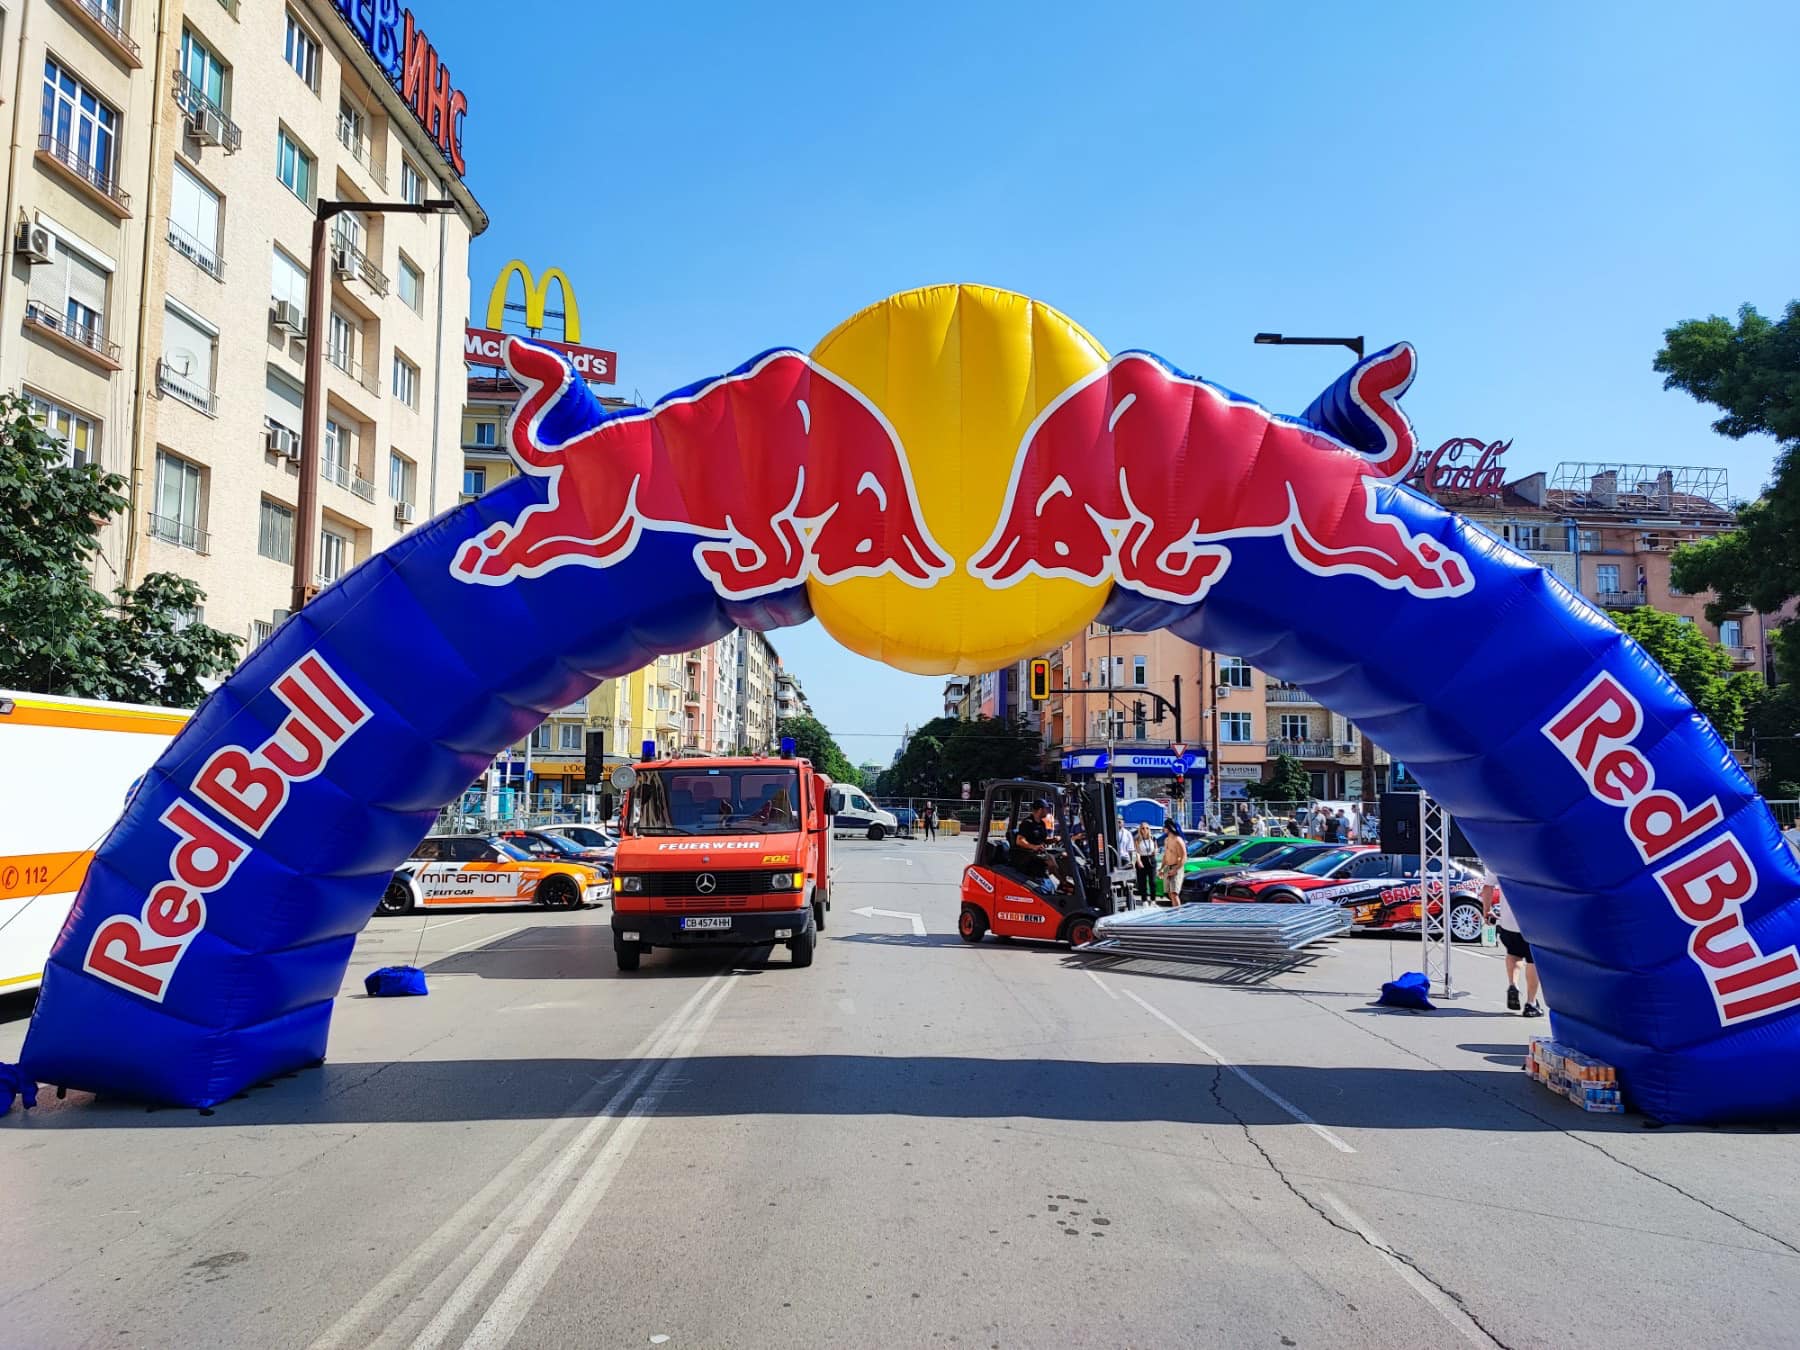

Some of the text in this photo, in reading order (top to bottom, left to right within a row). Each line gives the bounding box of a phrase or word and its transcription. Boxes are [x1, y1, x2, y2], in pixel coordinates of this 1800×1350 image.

[1132, 756, 1172, 765] ОПТИКА
[83, 649, 374, 1002] Red Bull
[658, 841, 760, 851] FEUERWEHR
[1542, 671, 1800, 1026] Red Bull
[25, 866, 48, 885] 112
